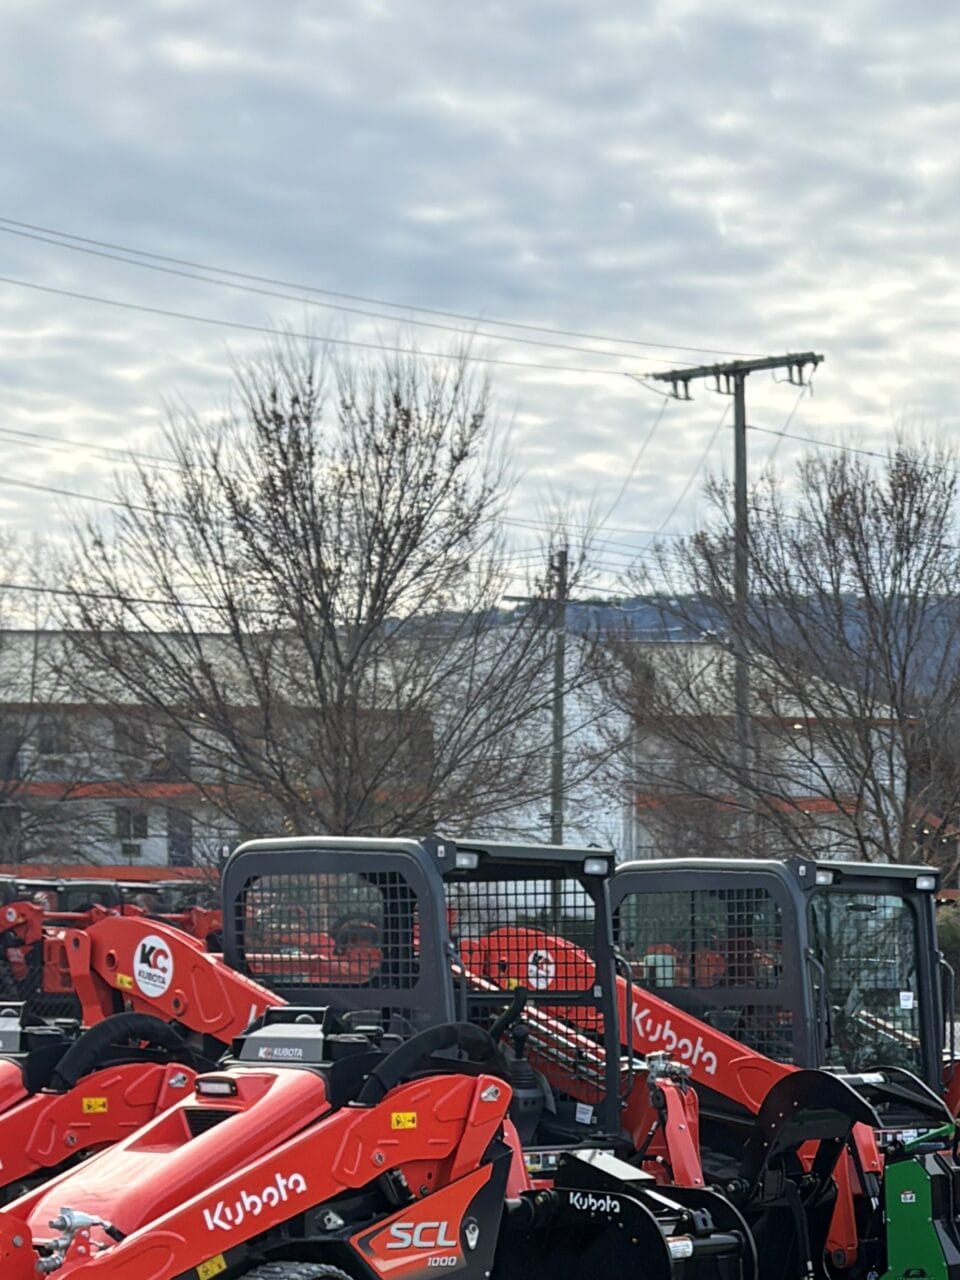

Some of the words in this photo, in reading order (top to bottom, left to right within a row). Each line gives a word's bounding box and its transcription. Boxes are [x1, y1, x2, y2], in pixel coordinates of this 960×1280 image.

[140, 943, 169, 974] KC
[631, 1002, 718, 1075] Kubota
[203, 1172, 308, 1231] Kubota
[569, 1191, 620, 1213] Kubota
[386, 1221, 457, 1250] SCL
[427, 1255, 458, 1267] 1000
